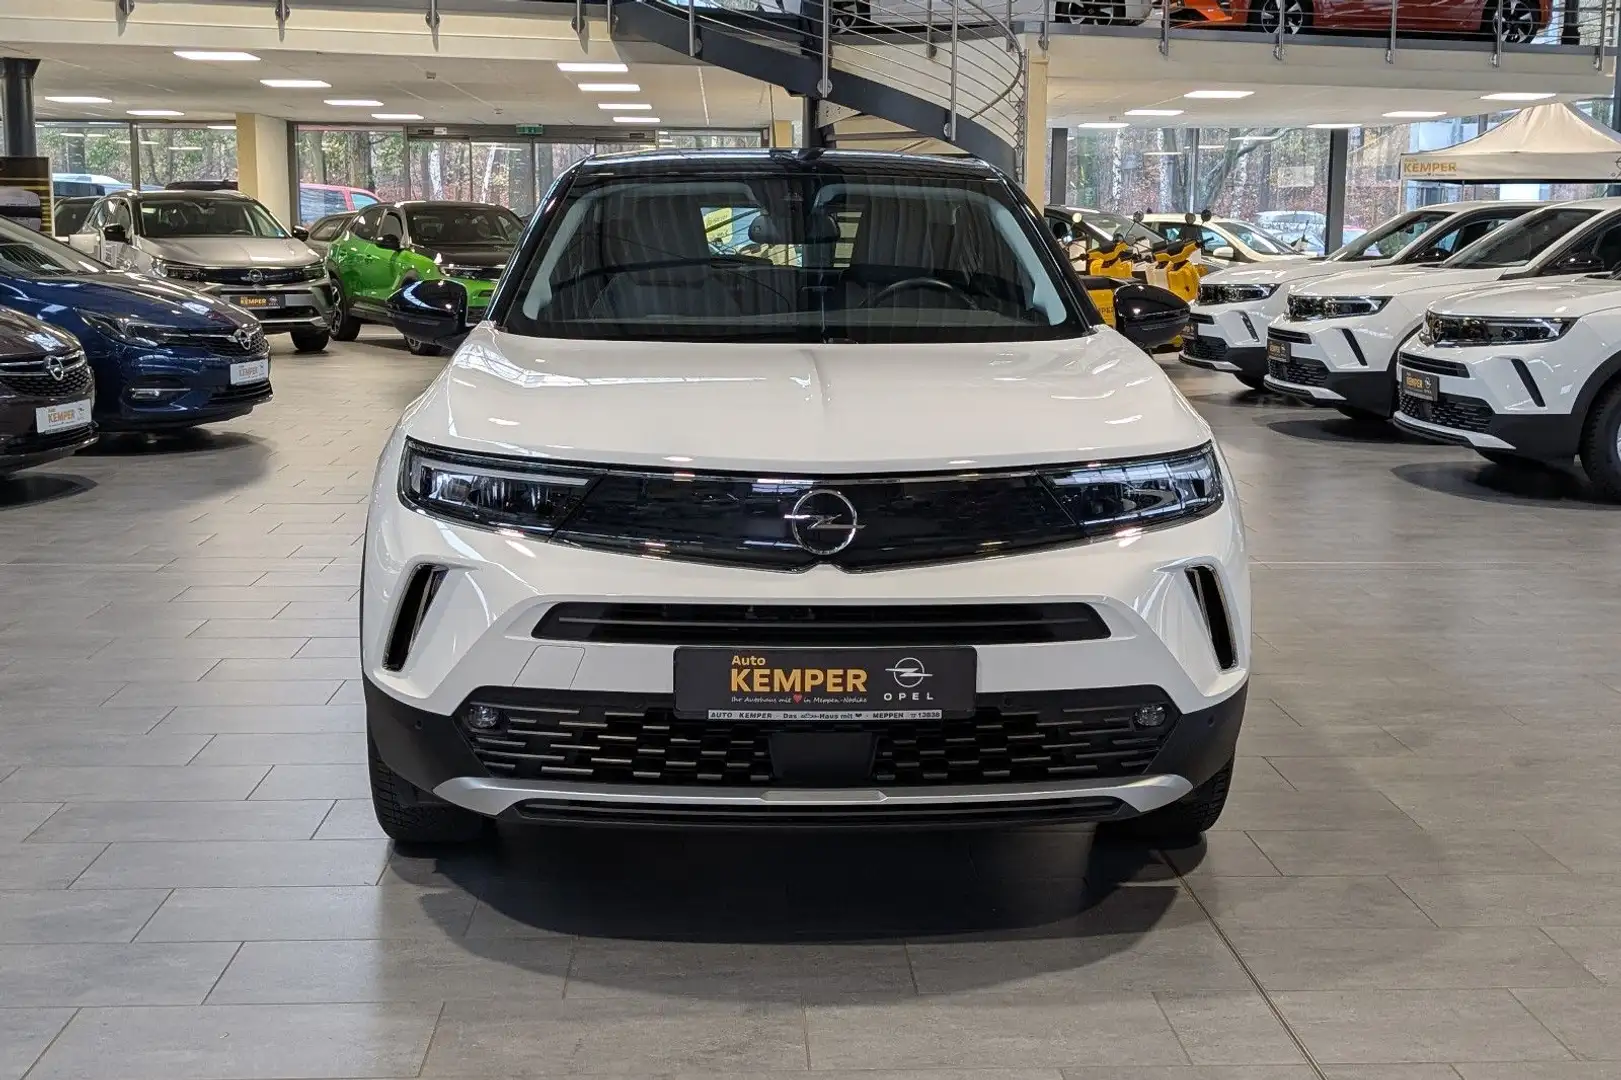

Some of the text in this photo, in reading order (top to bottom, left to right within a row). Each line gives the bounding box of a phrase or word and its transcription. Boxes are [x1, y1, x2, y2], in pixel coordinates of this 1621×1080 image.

[1404, 162, 1457, 173] KEMPER
[1406, 376, 1423, 388] KEMPER
[48, 409, 75, 423] KEMPER
[731, 655, 766, 666] Auto
[731, 668, 868, 692] KEMPER
[883, 692, 934, 701] OPEL
